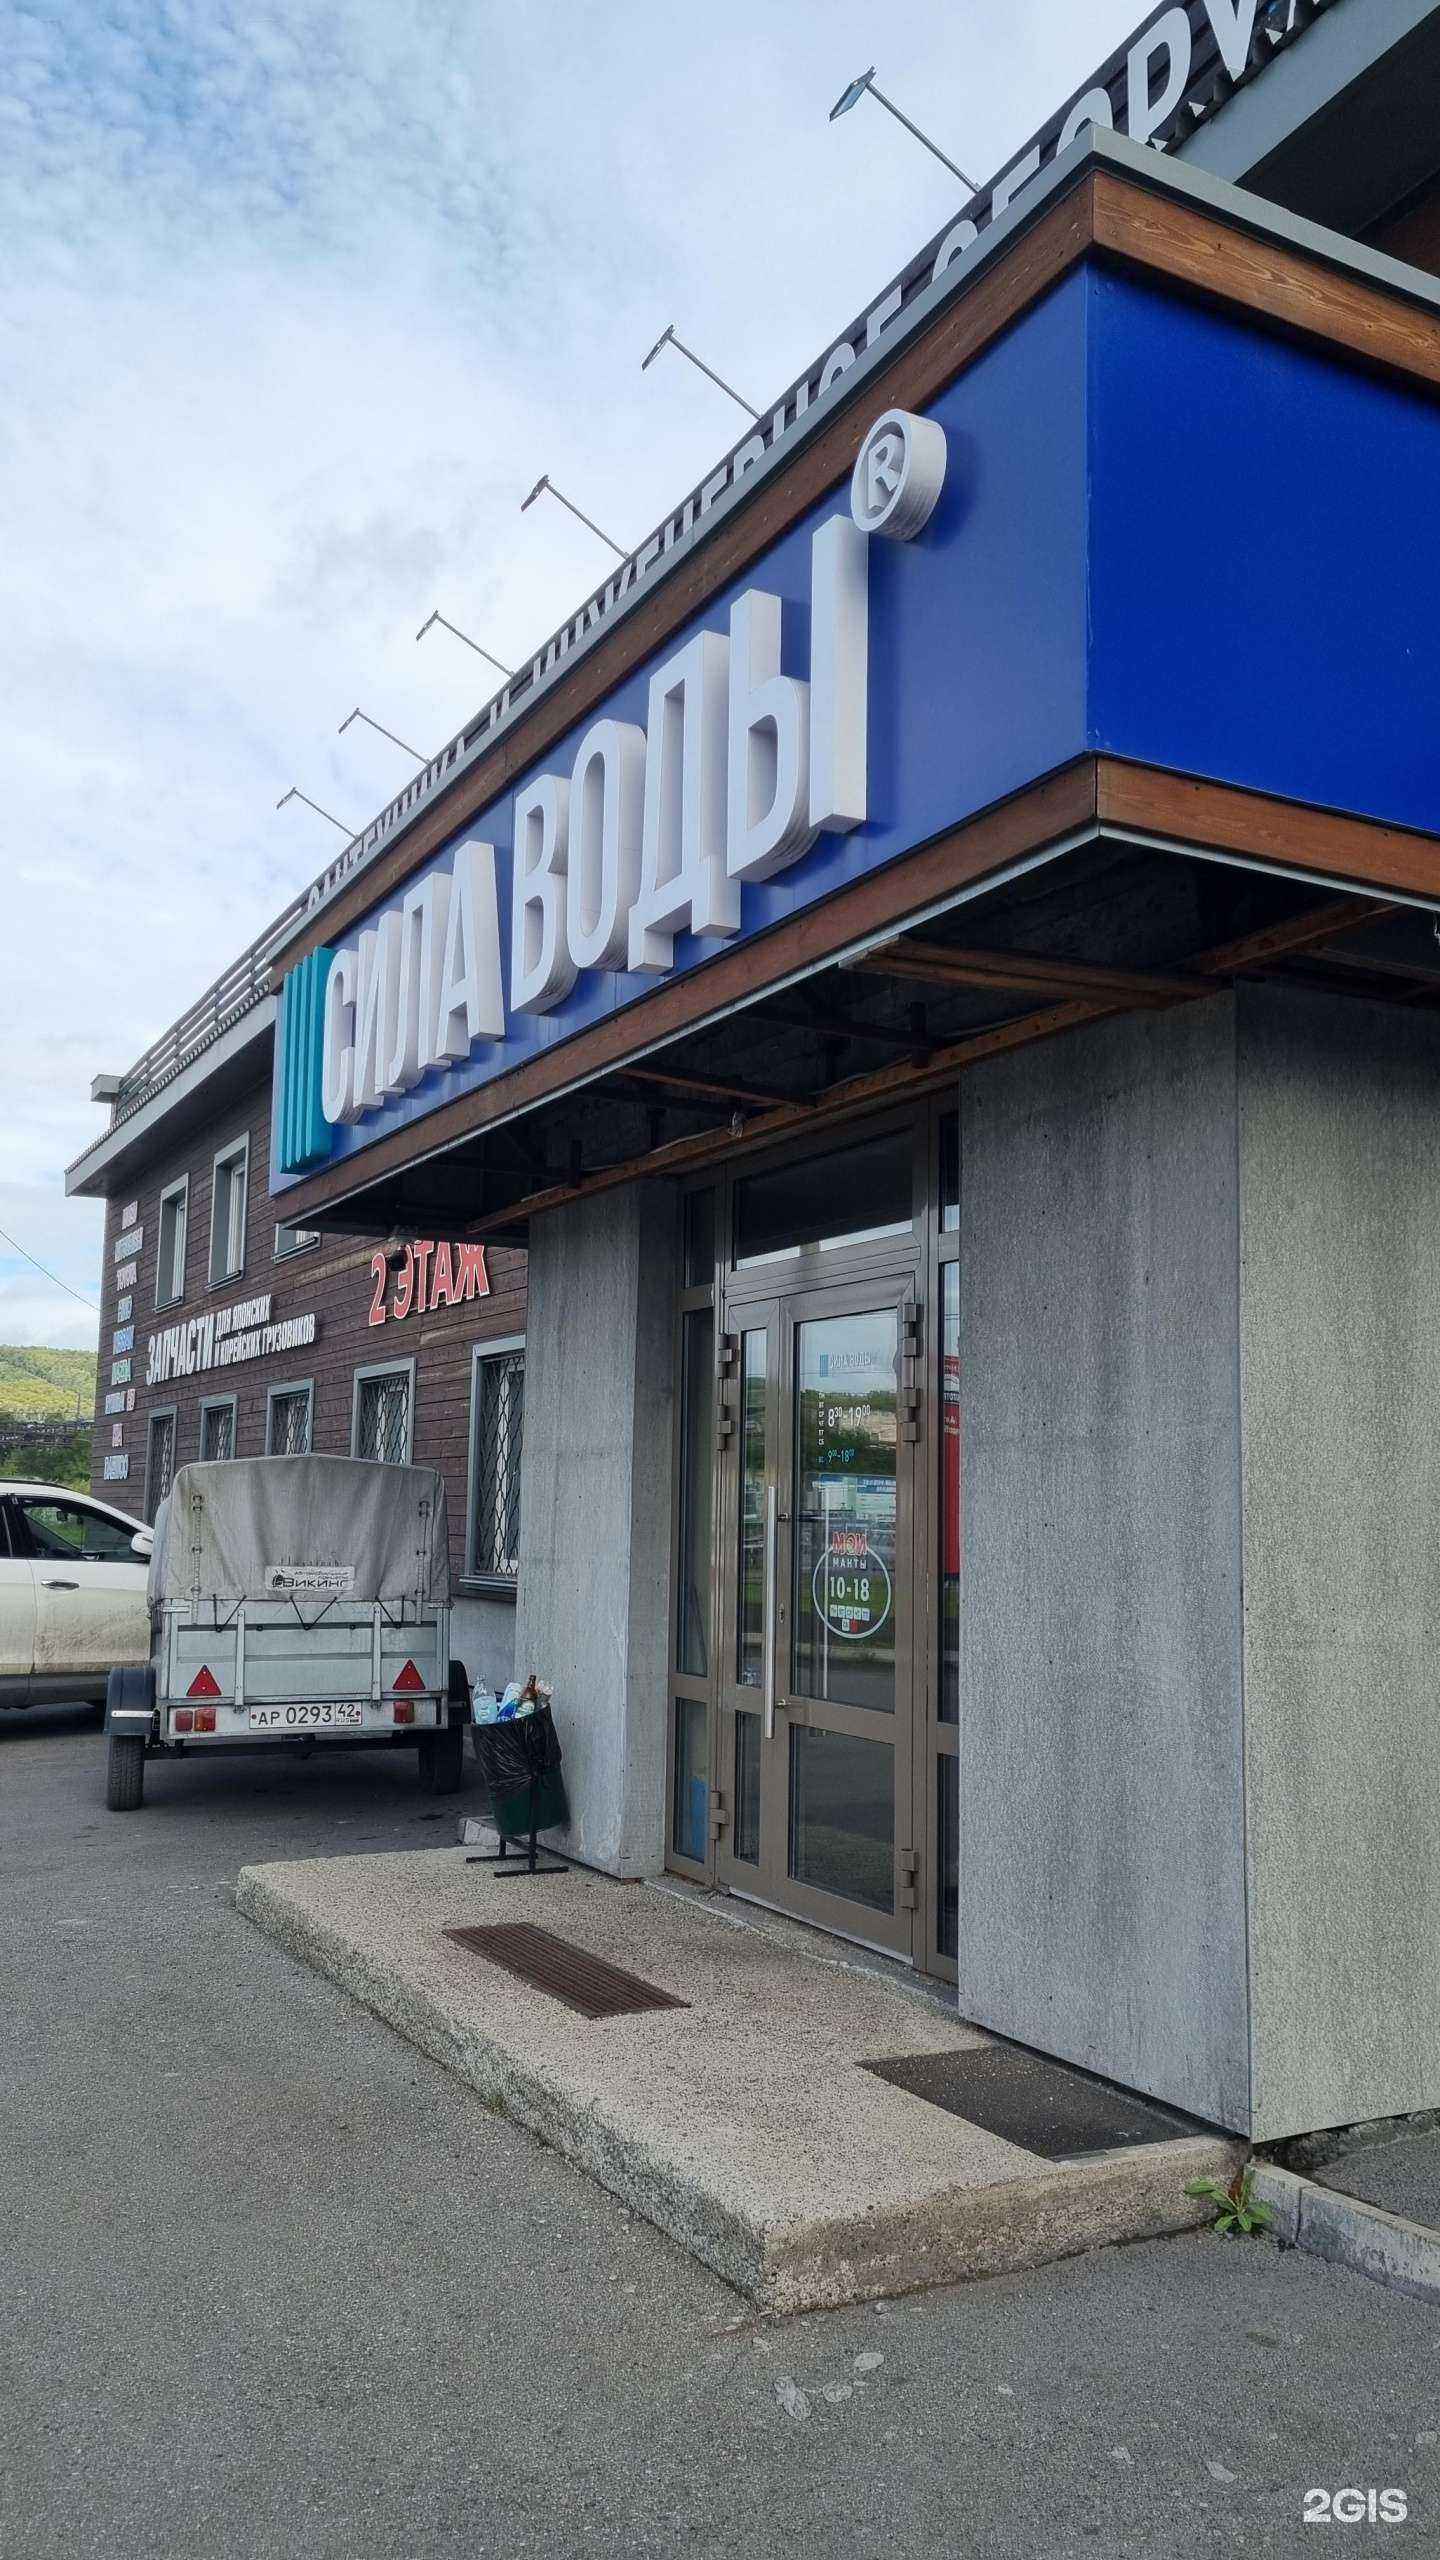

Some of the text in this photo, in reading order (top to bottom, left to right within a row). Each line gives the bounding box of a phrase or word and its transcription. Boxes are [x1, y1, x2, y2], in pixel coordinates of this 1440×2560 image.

[322, 839, 505, 1126] СИЛА
[511, 514, 869, 1015] ВОДЫ
[368, 1239, 490, 1327] 2 ЭТАЖ
[146, 1313, 215, 1386] ЗАПЧАСТИ
[215, 1307, 232, 1342] ДЛЯ
[233, 1293, 272, 1331] ЯПОНСКИХ
[220, 1329, 262, 1367] КОРЕЙСКИХ
[261, 1313, 316, 1356] ГРУЗОВИКОВ
[830, 1576, 870, 1602] 10-18
[832, 1557, 867, 1570] МАНТЫ
[285, 1705, 332, 1724] 0293
[337, 1704, 355, 1718] 42
